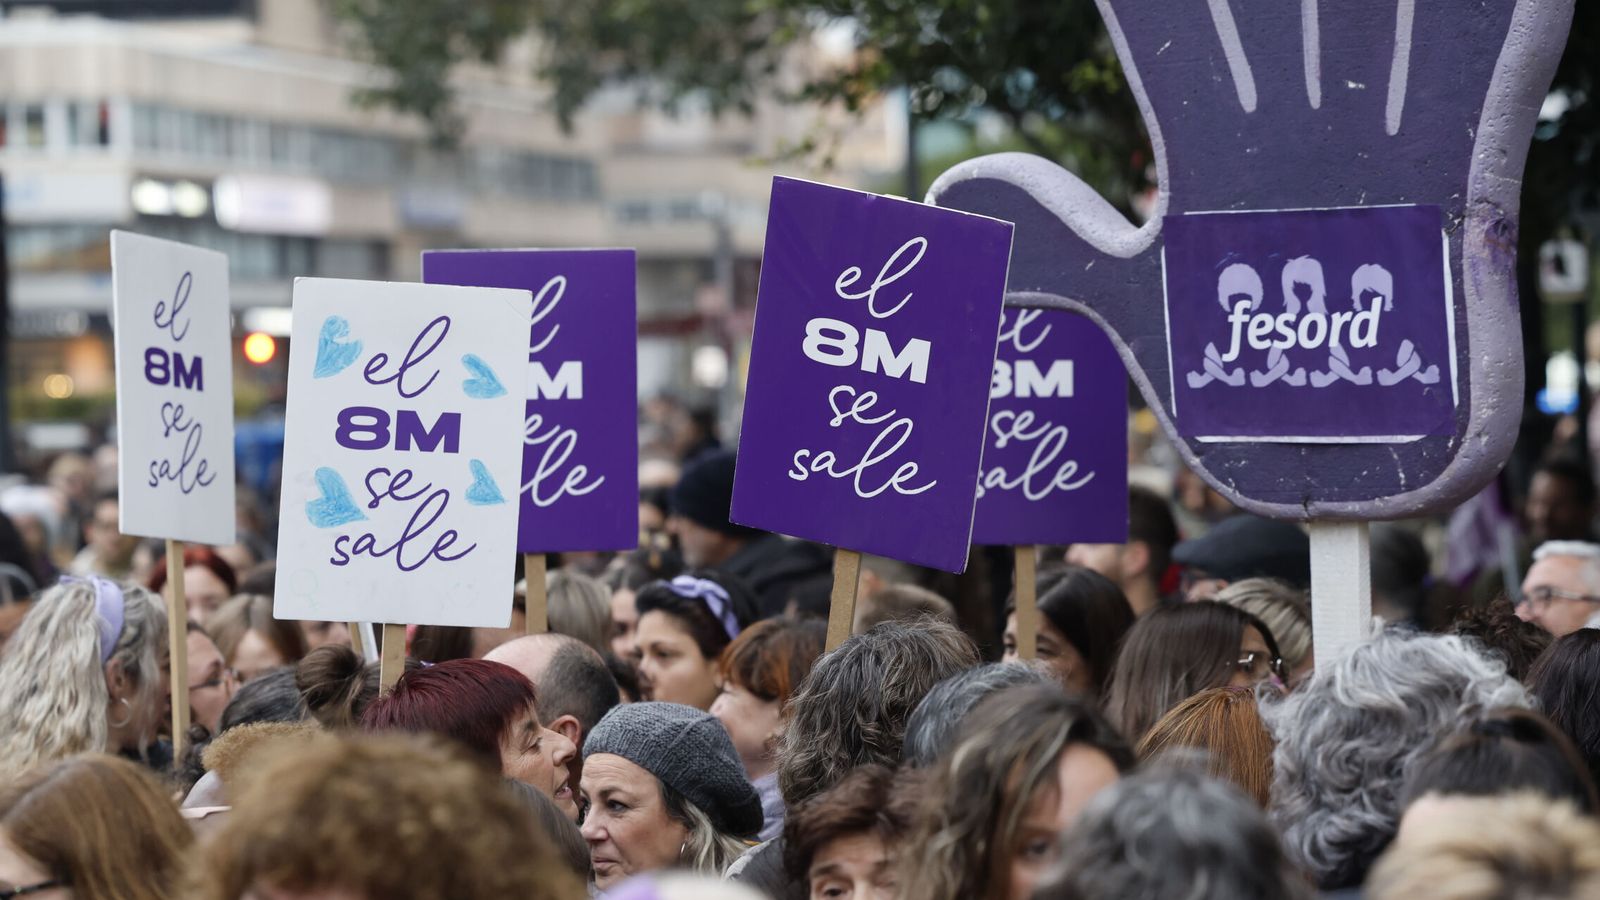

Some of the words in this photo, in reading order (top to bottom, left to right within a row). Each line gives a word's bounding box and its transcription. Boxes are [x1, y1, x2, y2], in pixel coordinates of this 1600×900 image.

[154, 271, 192, 342] el
[835, 237, 928, 319] el
[528, 275, 567, 353] l
[1222, 296, 1382, 362] fesord
[144, 346, 204, 392] 8M
[364, 316, 451, 399] el
[526, 361, 583, 400] M
[803, 317, 932, 384] 8M
[161, 401, 193, 438] se
[335, 407, 462, 454] 8M
[524, 413, 561, 445] e
[828, 384, 897, 427] se
[991, 410, 1052, 448] se
[148, 424, 215, 495] sale
[364, 467, 432, 509] se
[789, 417, 937, 499] sale
[330, 489, 477, 572] sale
